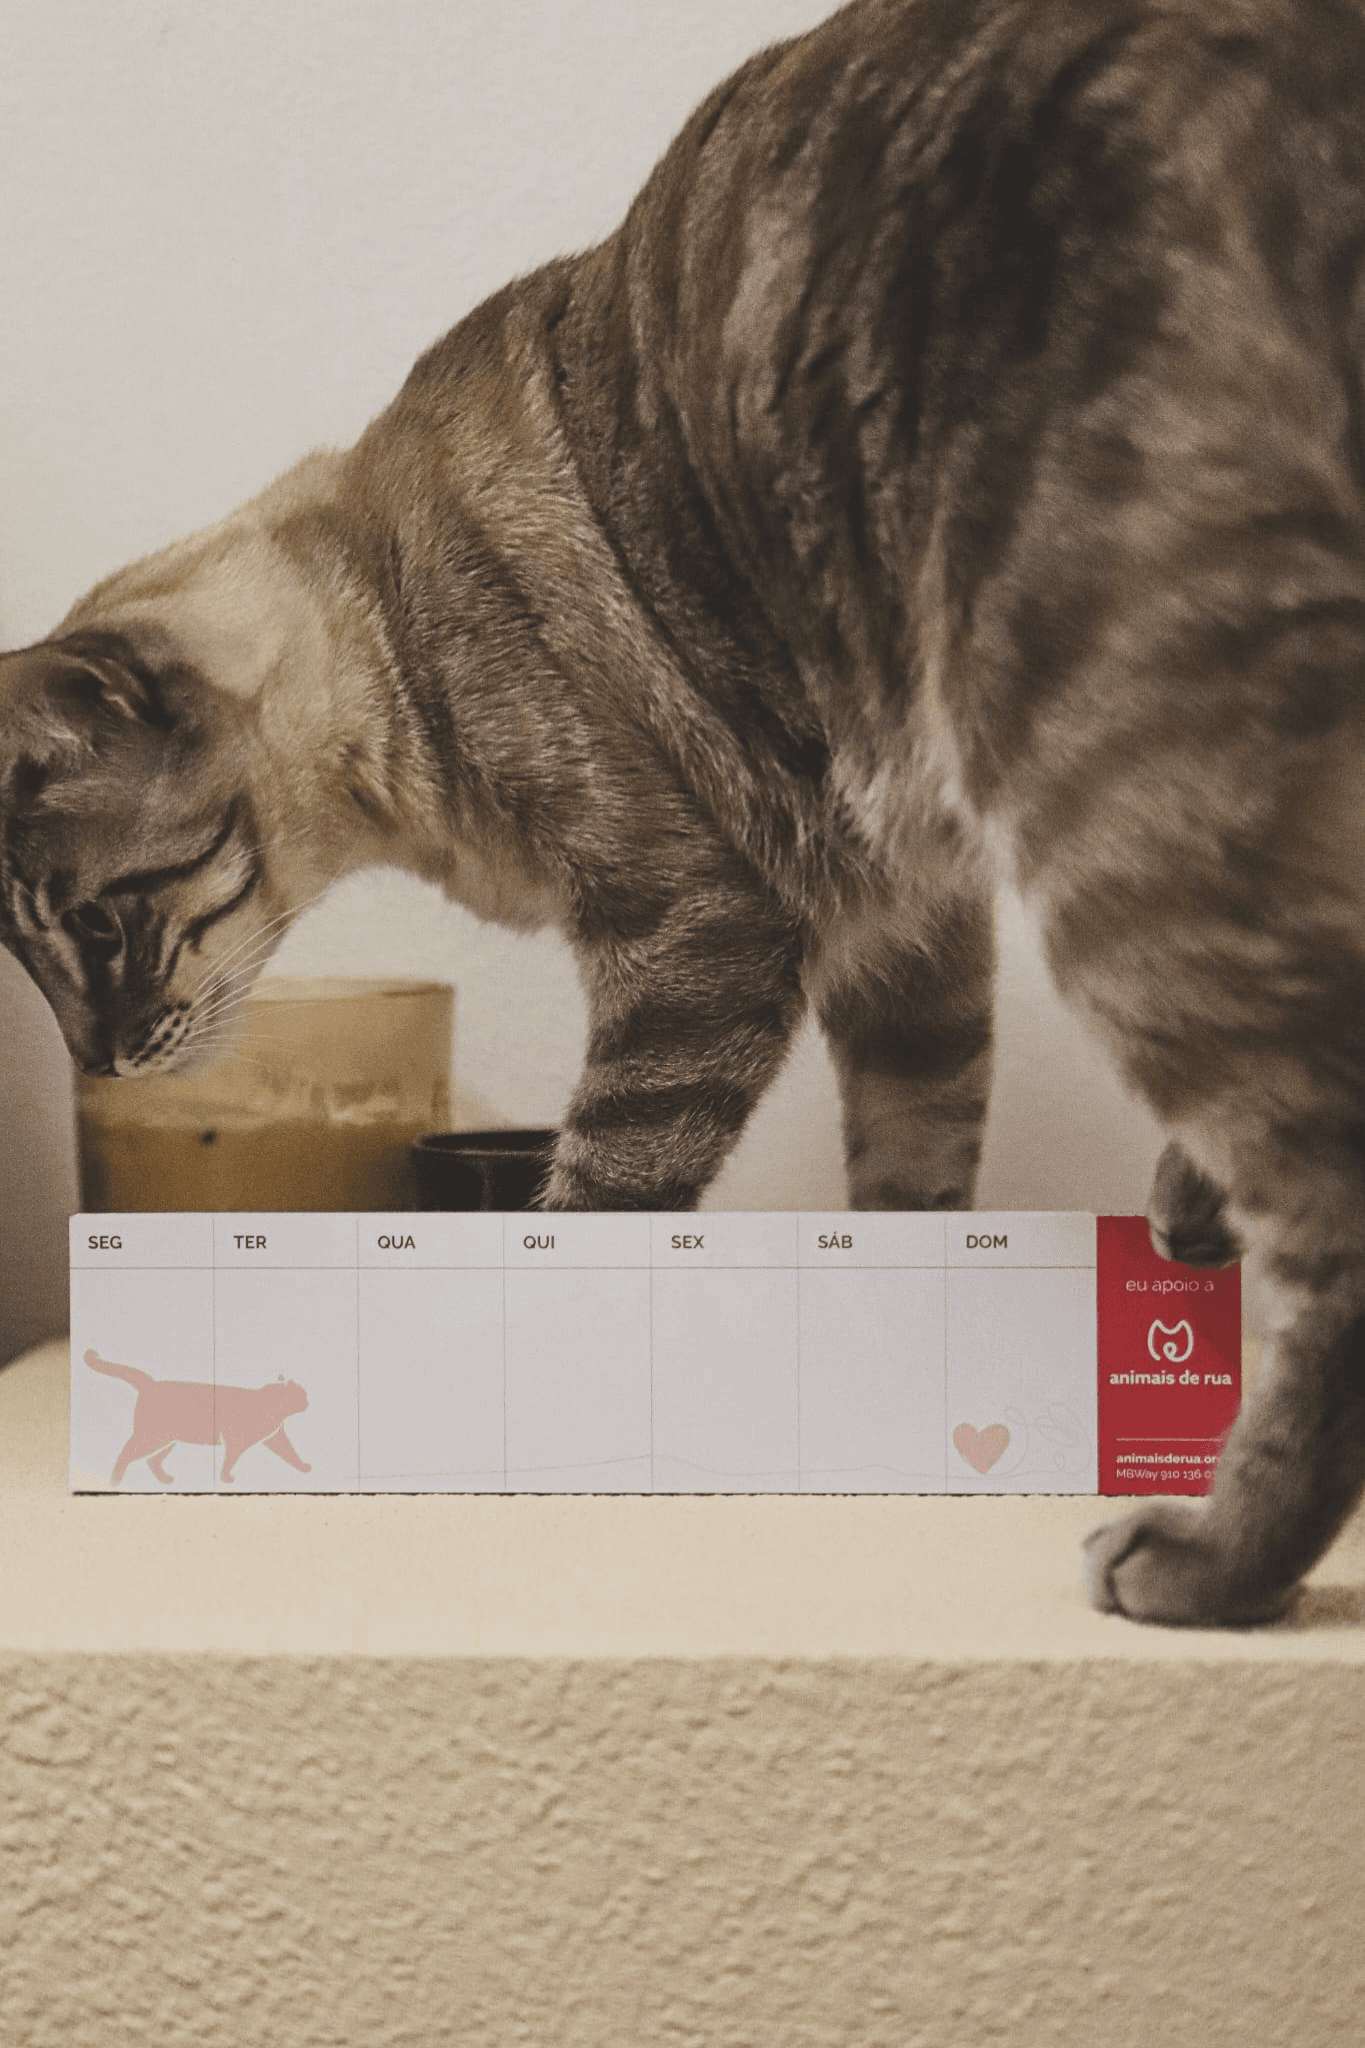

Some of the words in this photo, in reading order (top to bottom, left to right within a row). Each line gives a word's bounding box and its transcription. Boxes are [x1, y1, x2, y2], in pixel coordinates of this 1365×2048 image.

[87, 1235, 123, 1250] SEG
[233, 1235, 267, 1250] TER
[377, 1235, 416, 1251] QUA
[523, 1235, 555, 1251] QUI
[670, 1235, 704, 1250] SEX
[817, 1231, 853, 1250] SÁB
[966, 1235, 1008, 1250] DOM
[1125, 1279, 1148, 1292] eu
[1151, 1277, 1200, 1295] apoio
[1203, 1280, 1214, 1292] a
[1109, 1370, 1175, 1385] animais
[1178, 1370, 1199, 1385] de
[1203, 1373, 1232, 1385] rua
[1115, 1452, 1217, 1464] animaisderua.or
[1160, 1469, 1180, 1481] 910
